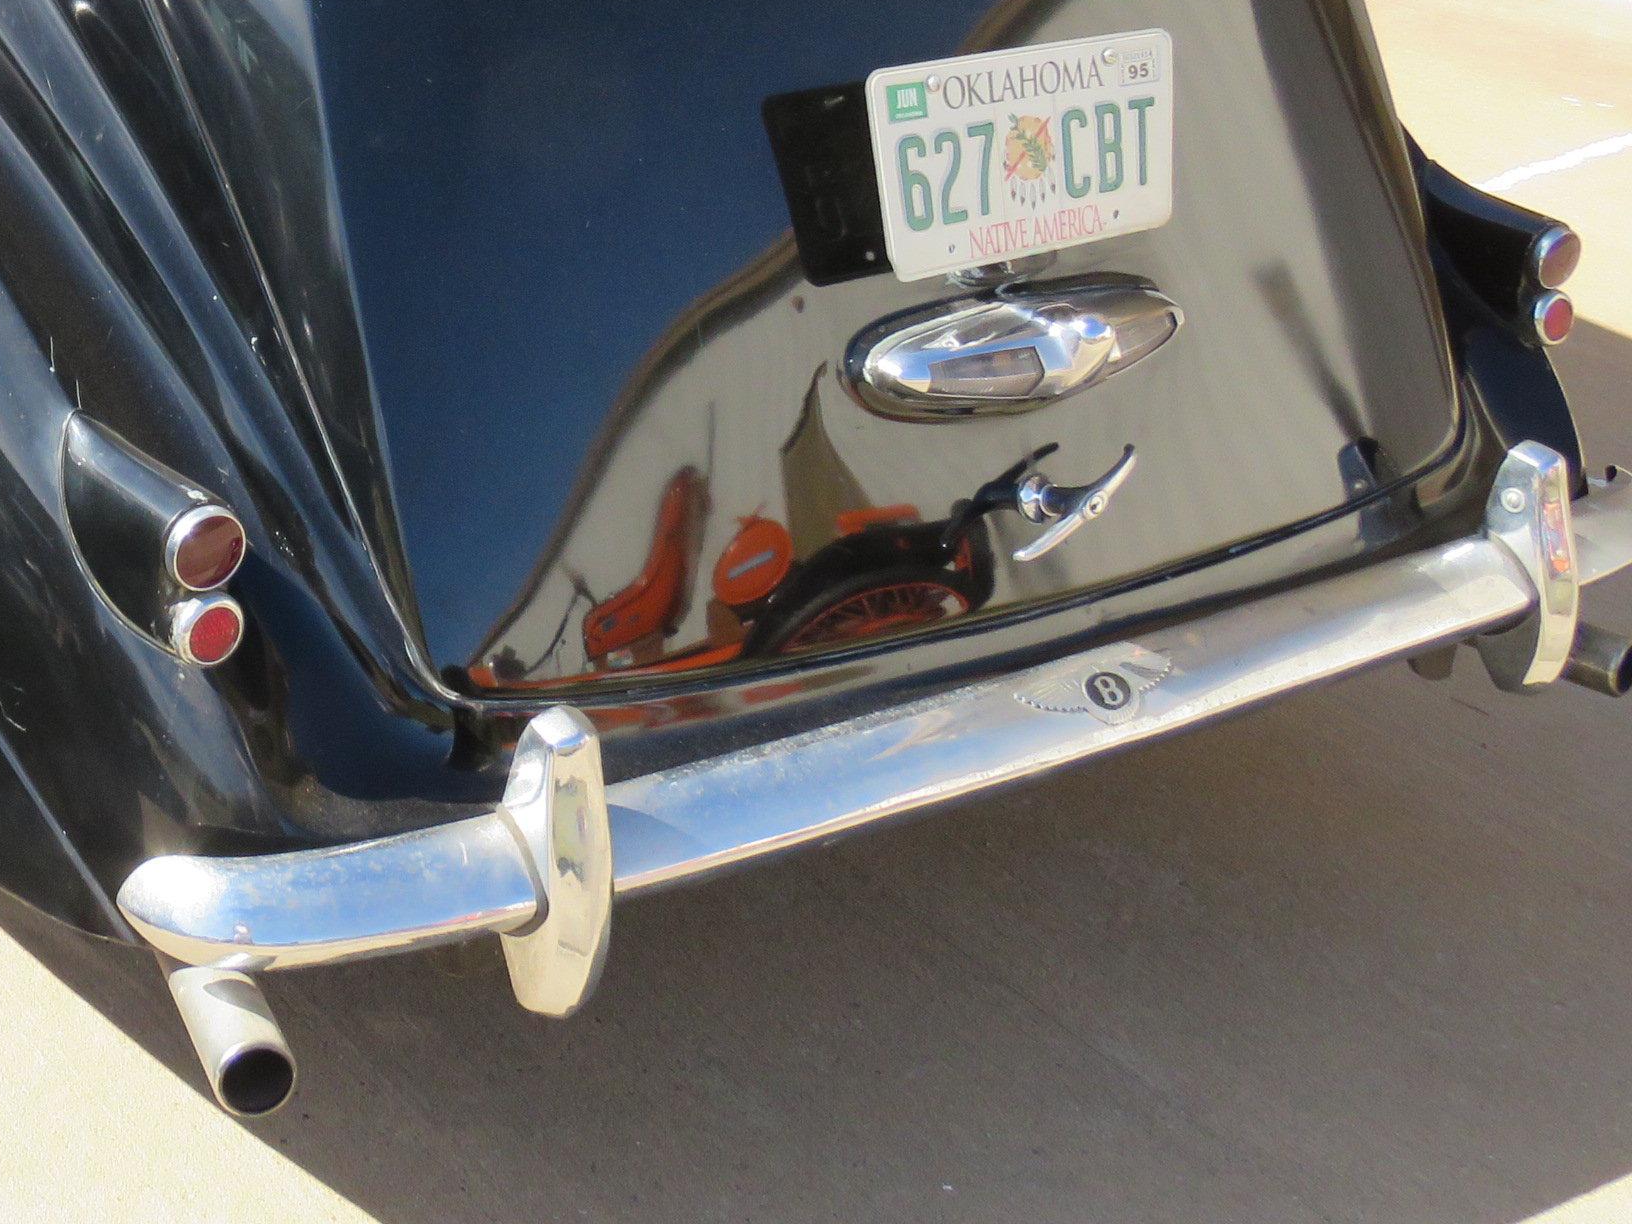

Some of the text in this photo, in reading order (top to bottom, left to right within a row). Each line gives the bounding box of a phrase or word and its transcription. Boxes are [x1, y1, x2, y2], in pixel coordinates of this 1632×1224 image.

[896, 87, 919, 109] JUN
[942, 55, 1104, 110] OKLAHOMA
[1128, 62, 1149, 80] 95
[897, 96, 1156, 233] 627 CBT
[968, 204, 1104, 259] NATIVE AMERICA
